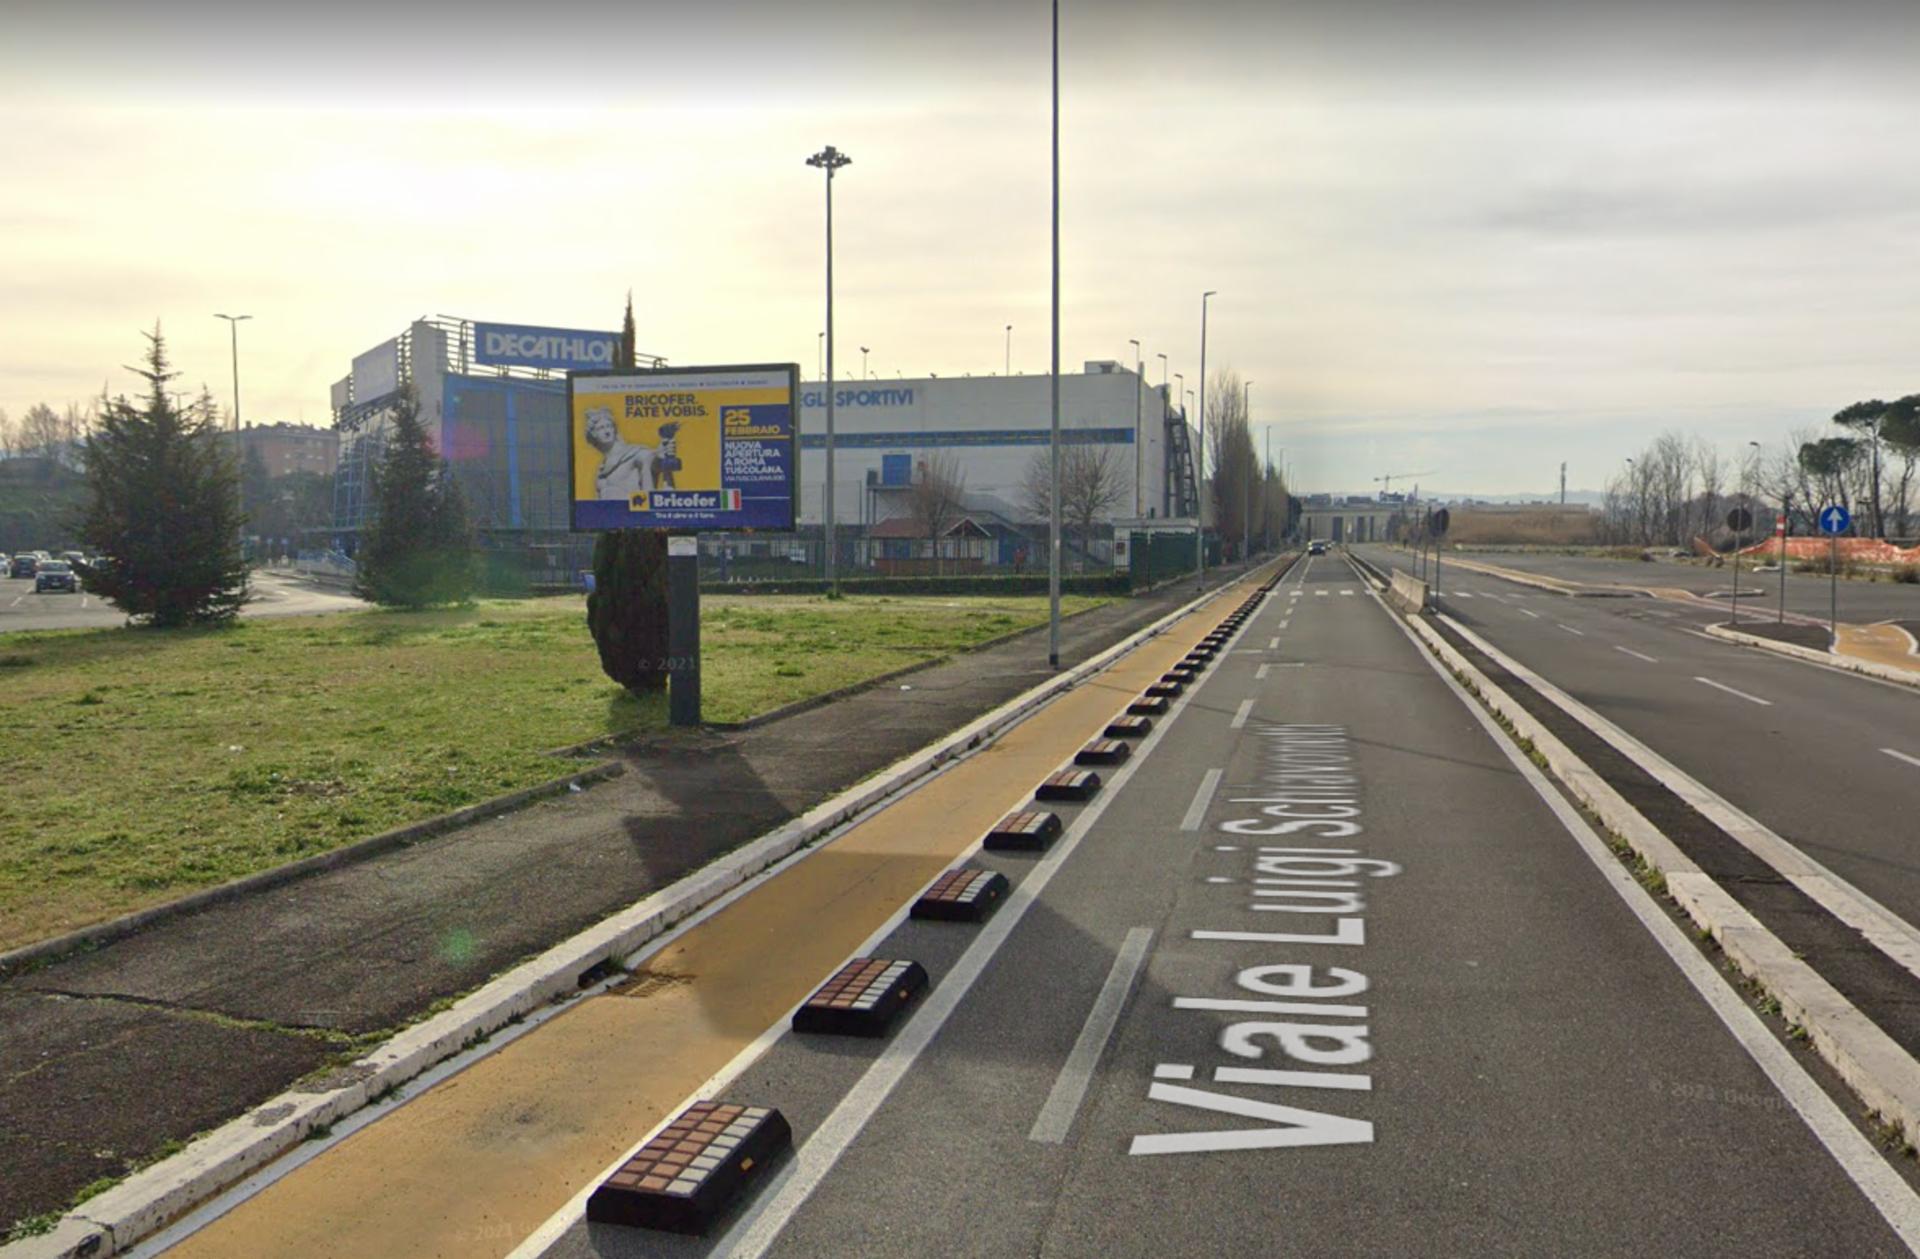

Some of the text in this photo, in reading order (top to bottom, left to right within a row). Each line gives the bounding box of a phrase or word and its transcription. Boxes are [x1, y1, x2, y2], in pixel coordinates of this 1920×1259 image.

[835, 388, 914, 407] SPORTIVI
[624, 405, 709, 418] FATE VOBIS.
[725, 409, 751, 426] 25
[725, 425, 780, 435] FEBBRAIO
[725, 441, 762, 450] NUOVA
[725, 448, 781, 458] APERTURA
[653, 493, 716, 508] Bricofer
